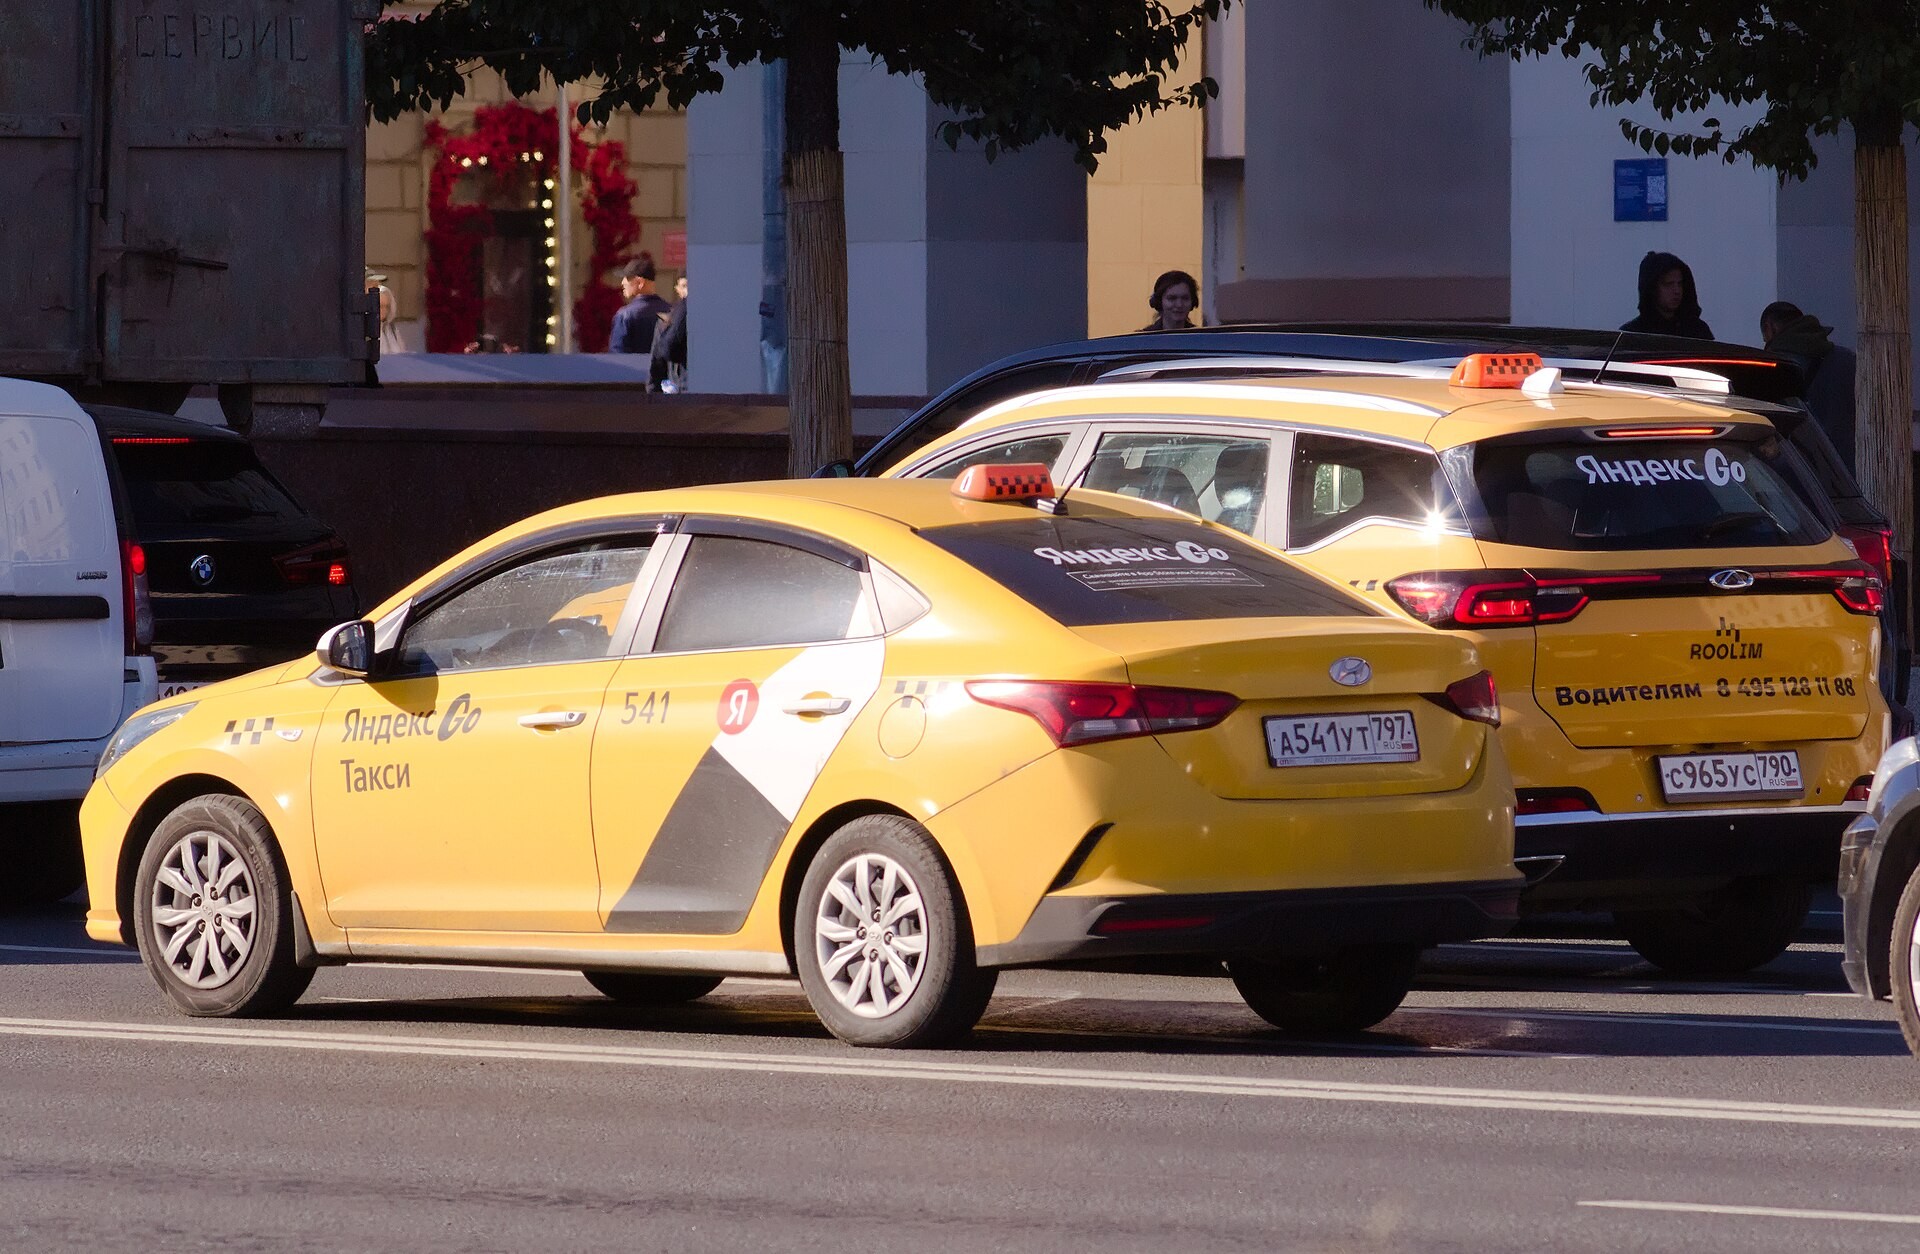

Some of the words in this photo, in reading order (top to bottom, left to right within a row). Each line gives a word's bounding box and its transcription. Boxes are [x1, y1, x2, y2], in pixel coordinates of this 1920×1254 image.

[135, 14, 309, 62] СЕРВИС
[1575, 455, 1704, 486] Яндекс
[1704, 447, 1746, 487] Go
[1033, 547, 1181, 566] Яндекс
[1175, 540, 1229, 564] Go
[1690, 642, 1763, 660] ROOLIM
[1554, 680, 1702, 707] Водителям
[1716, 677, 1731, 698] 8
[1737, 677, 1776, 698] 495
[1779, 676, 1811, 697] 128
[1815, 676, 1831, 697] 11
[1834, 677, 1856, 697] 88
[341, 708, 437, 745] Яндекс
[437, 693, 482, 742] Go
[620, 691, 670, 725] 541
[725, 689, 749, 726] Я
[1371, 716, 1405, 741] 797
[1383, 740, 1402, 750] RUS
[340, 759, 411, 793] Такси
[1757, 754, 1792, 778] 790
[1769, 778, 1786, 787] RUS
